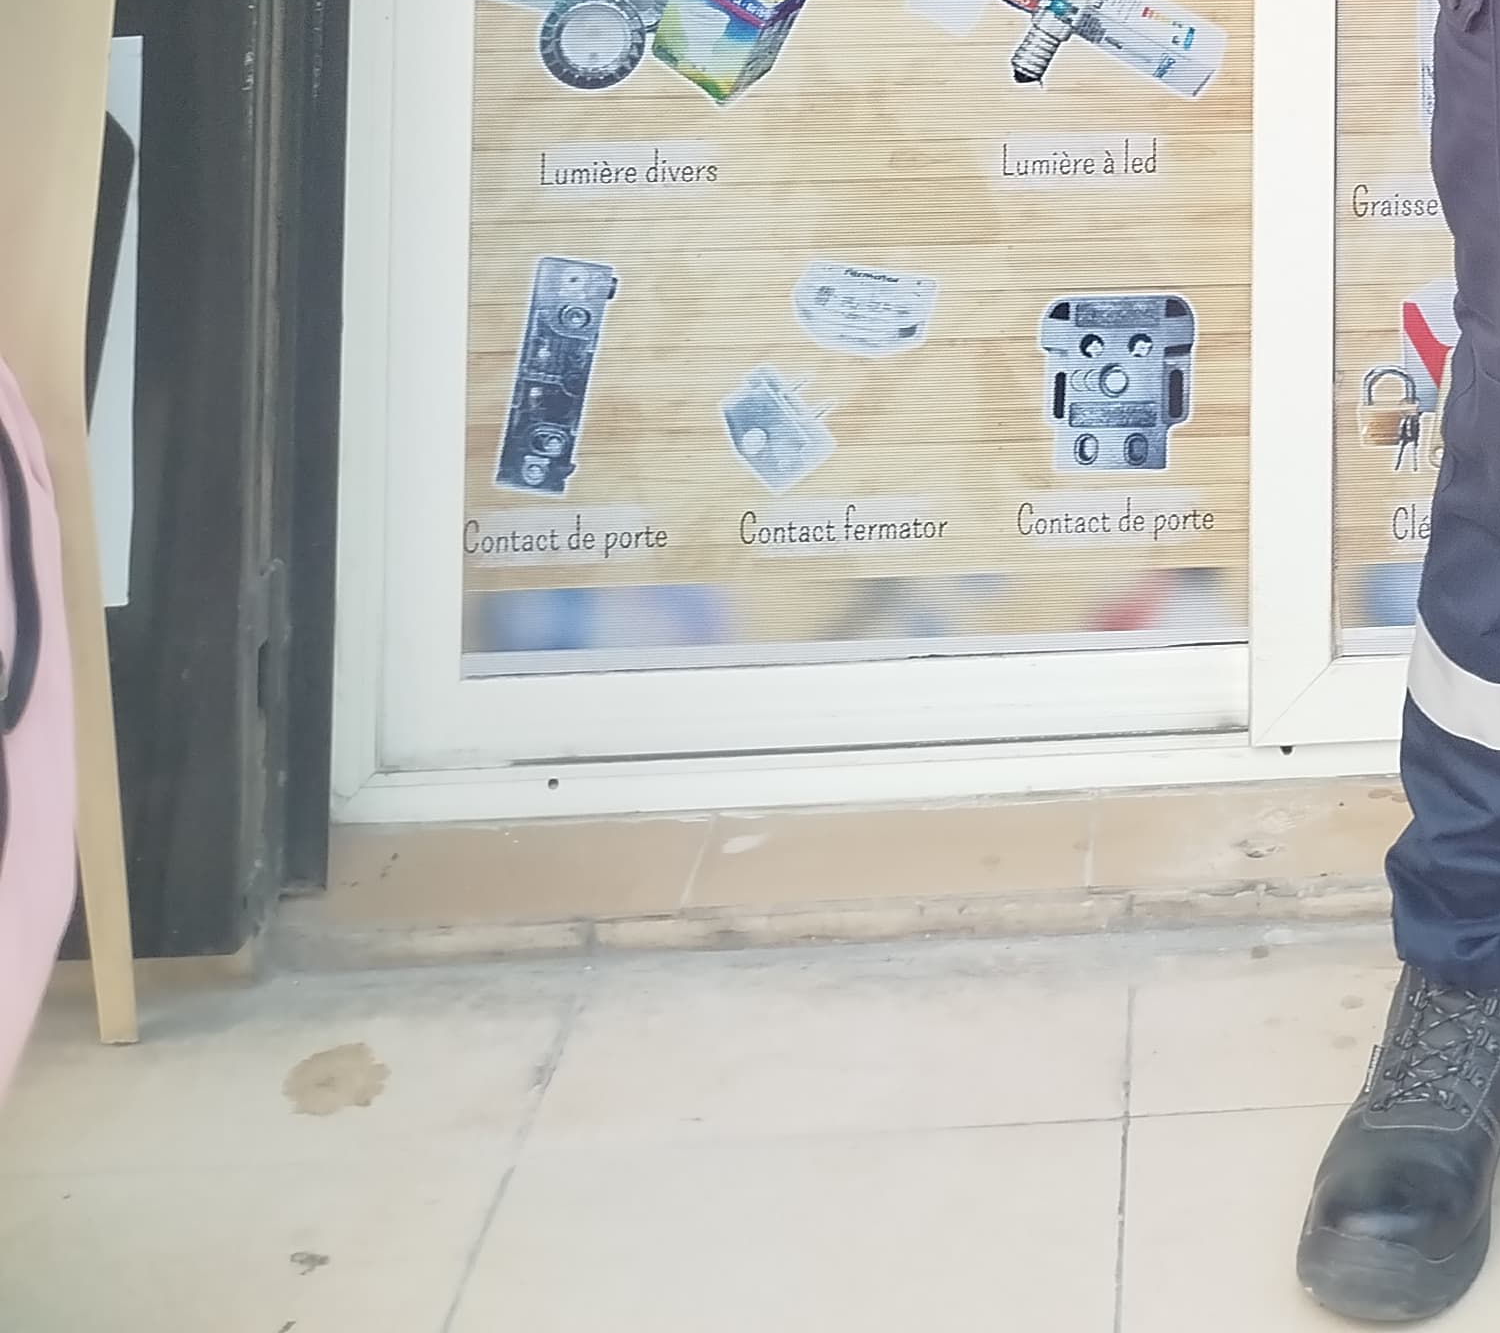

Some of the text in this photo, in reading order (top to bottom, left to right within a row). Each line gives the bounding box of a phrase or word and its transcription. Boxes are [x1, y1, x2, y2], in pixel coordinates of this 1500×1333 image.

[540, 149, 718, 188] Lumière divers
[1001, 138, 1157, 180] Lumière à led
[1352, 183, 1440, 221] Graisse
[462, 516, 667, 561] Contact de porte
[740, 505, 948, 547] Contact fermator
[1018, 497, 1215, 542] Contact de porte
[1393, 502, 1431, 541] Clé
